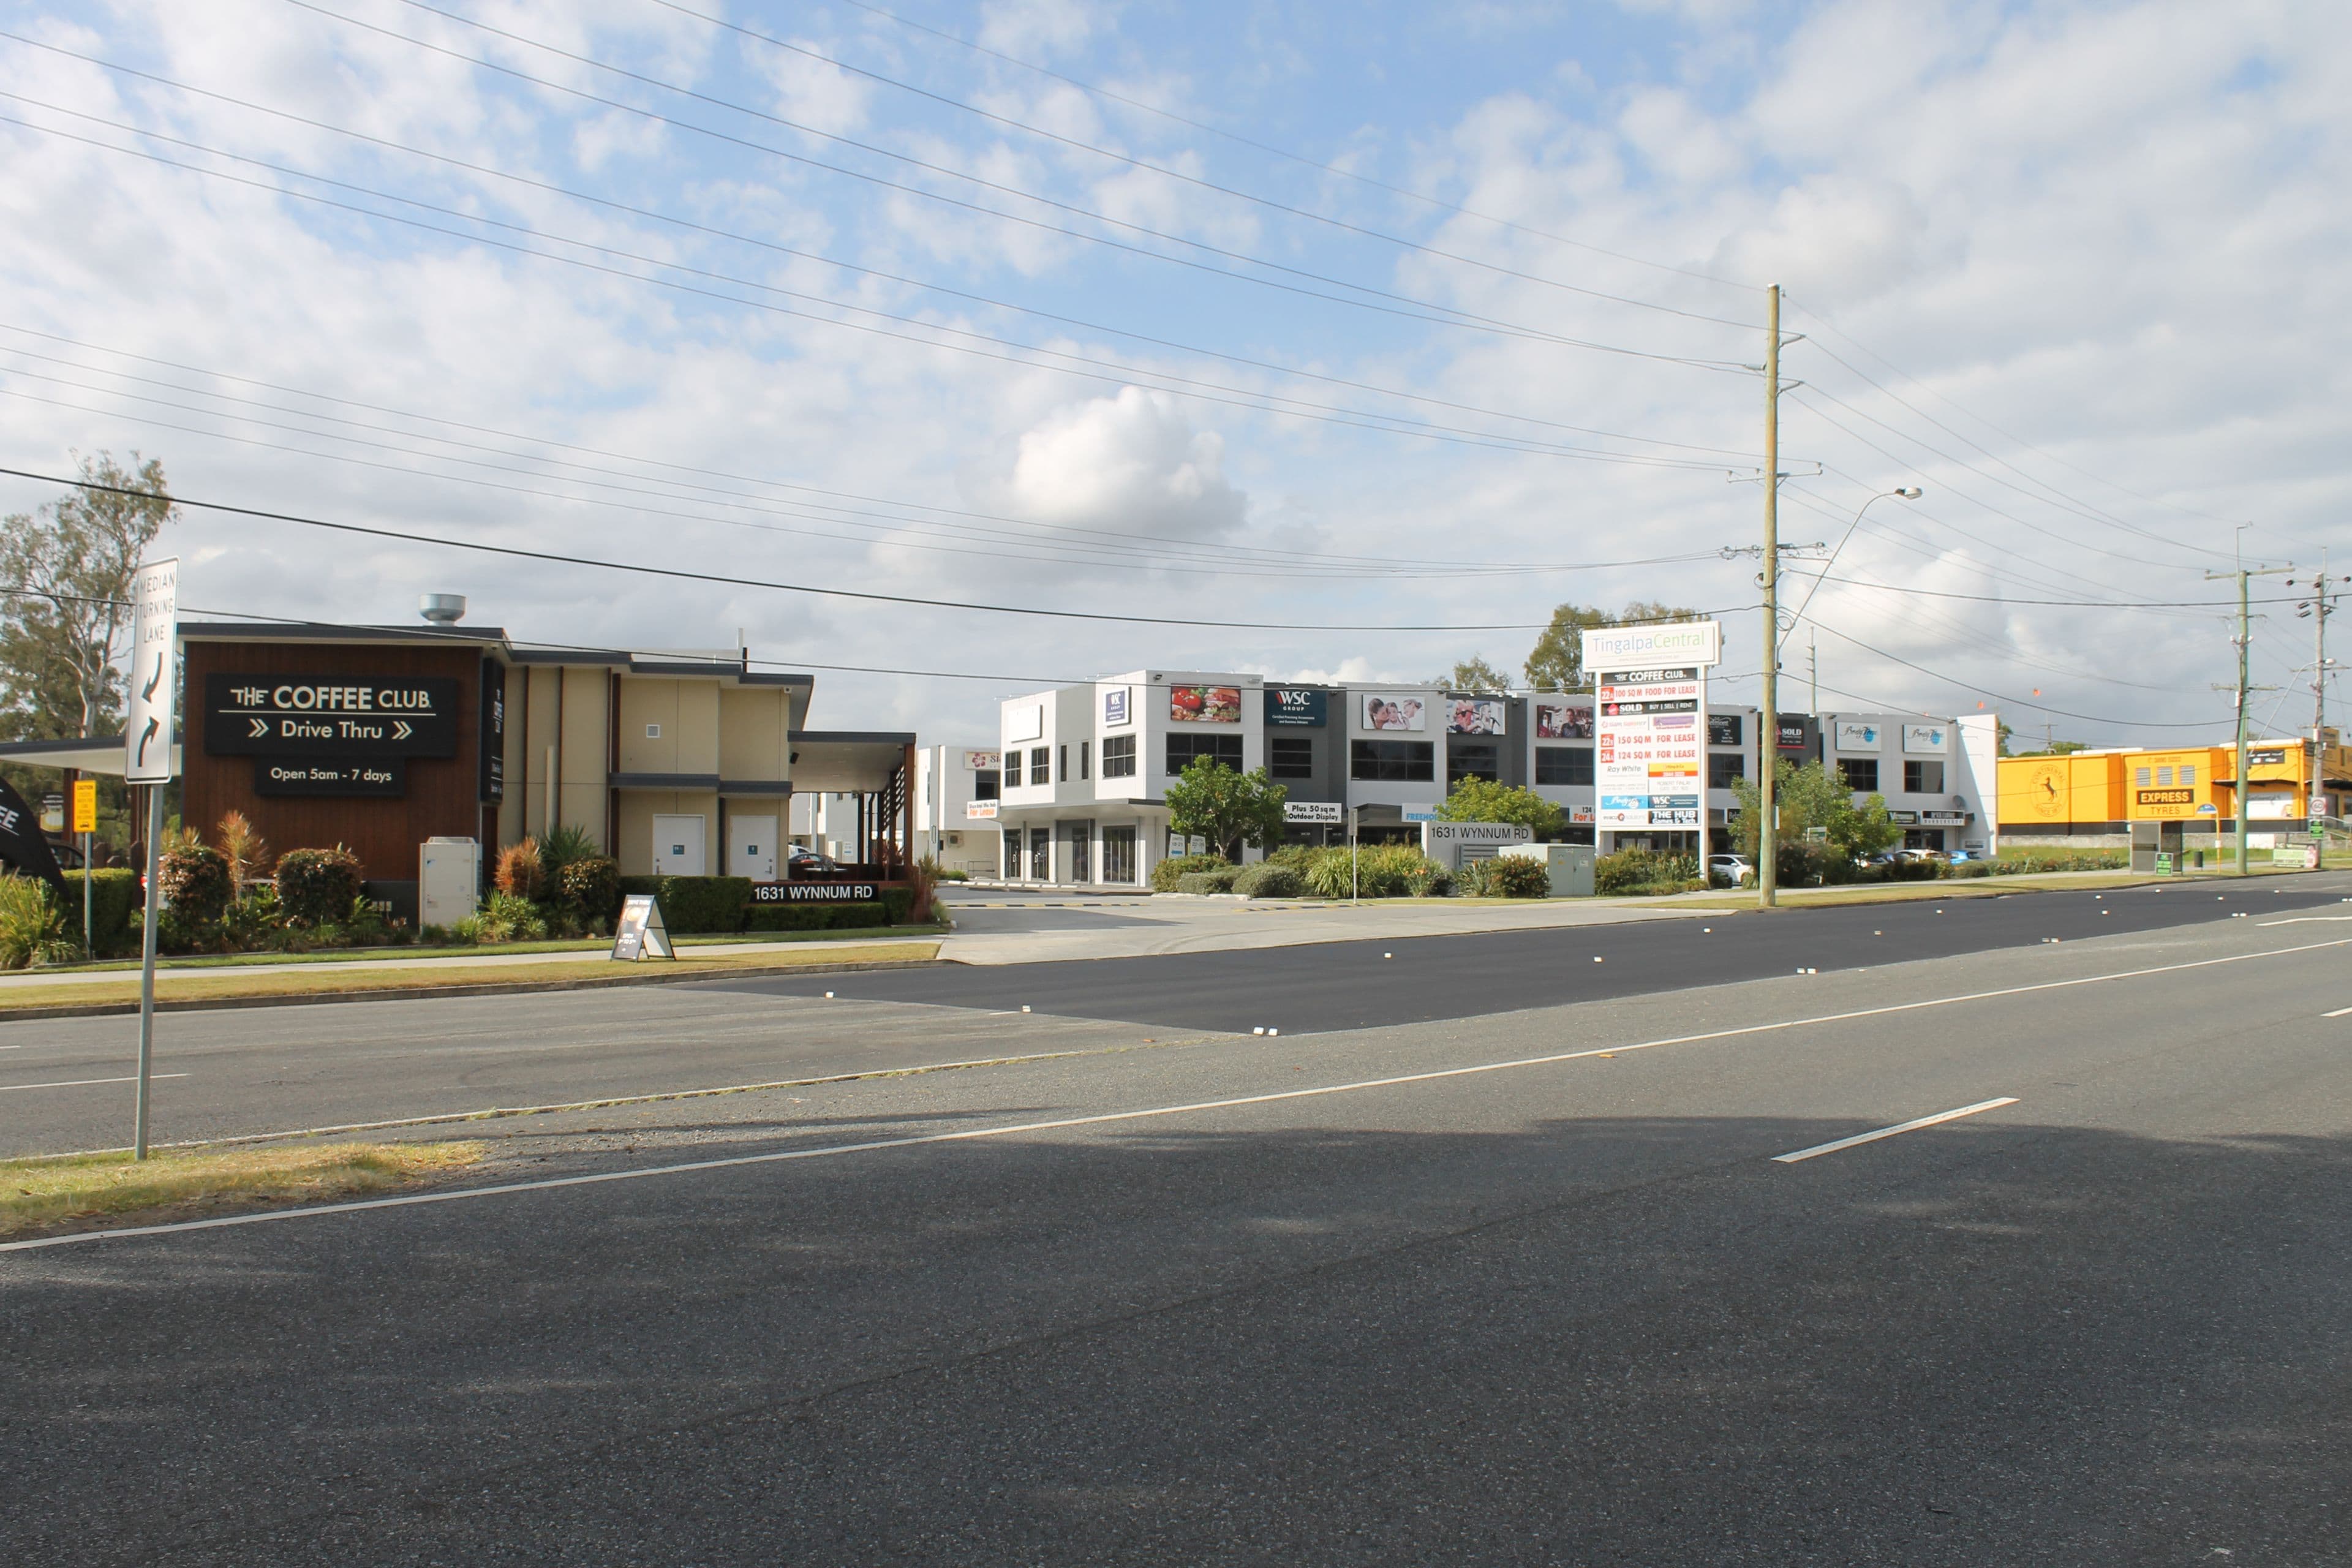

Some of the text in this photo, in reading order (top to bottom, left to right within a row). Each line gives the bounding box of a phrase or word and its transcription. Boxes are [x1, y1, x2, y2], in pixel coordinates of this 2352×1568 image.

[140, 573, 175, 593] MEDIAN
[139, 598, 173, 619] TURNING
[144, 625, 164, 643] LANE
[1629, 671, 1664, 682] COFFEE
[1678, 685, 1696, 694] LEASE
[230, 687, 268, 706] THE
[274, 686, 372, 709] COFFEE
[1278, 690, 1311, 705] WSC
[281, 720, 383, 739] Drive Thru
[270, 767, 306, 782] Open
[310, 768, 338, 780] 5am
[352, 769, 360, 780] 7
[363, 769, 392, 783] days
[2141, 791, 2190, 803] EXPRESS
[2150, 806, 2180, 815] TYRES
[1431, 827, 1529, 839] 1631 WYNNUM RD
[754, 886, 873, 900] 1631 WYNNUM RD
